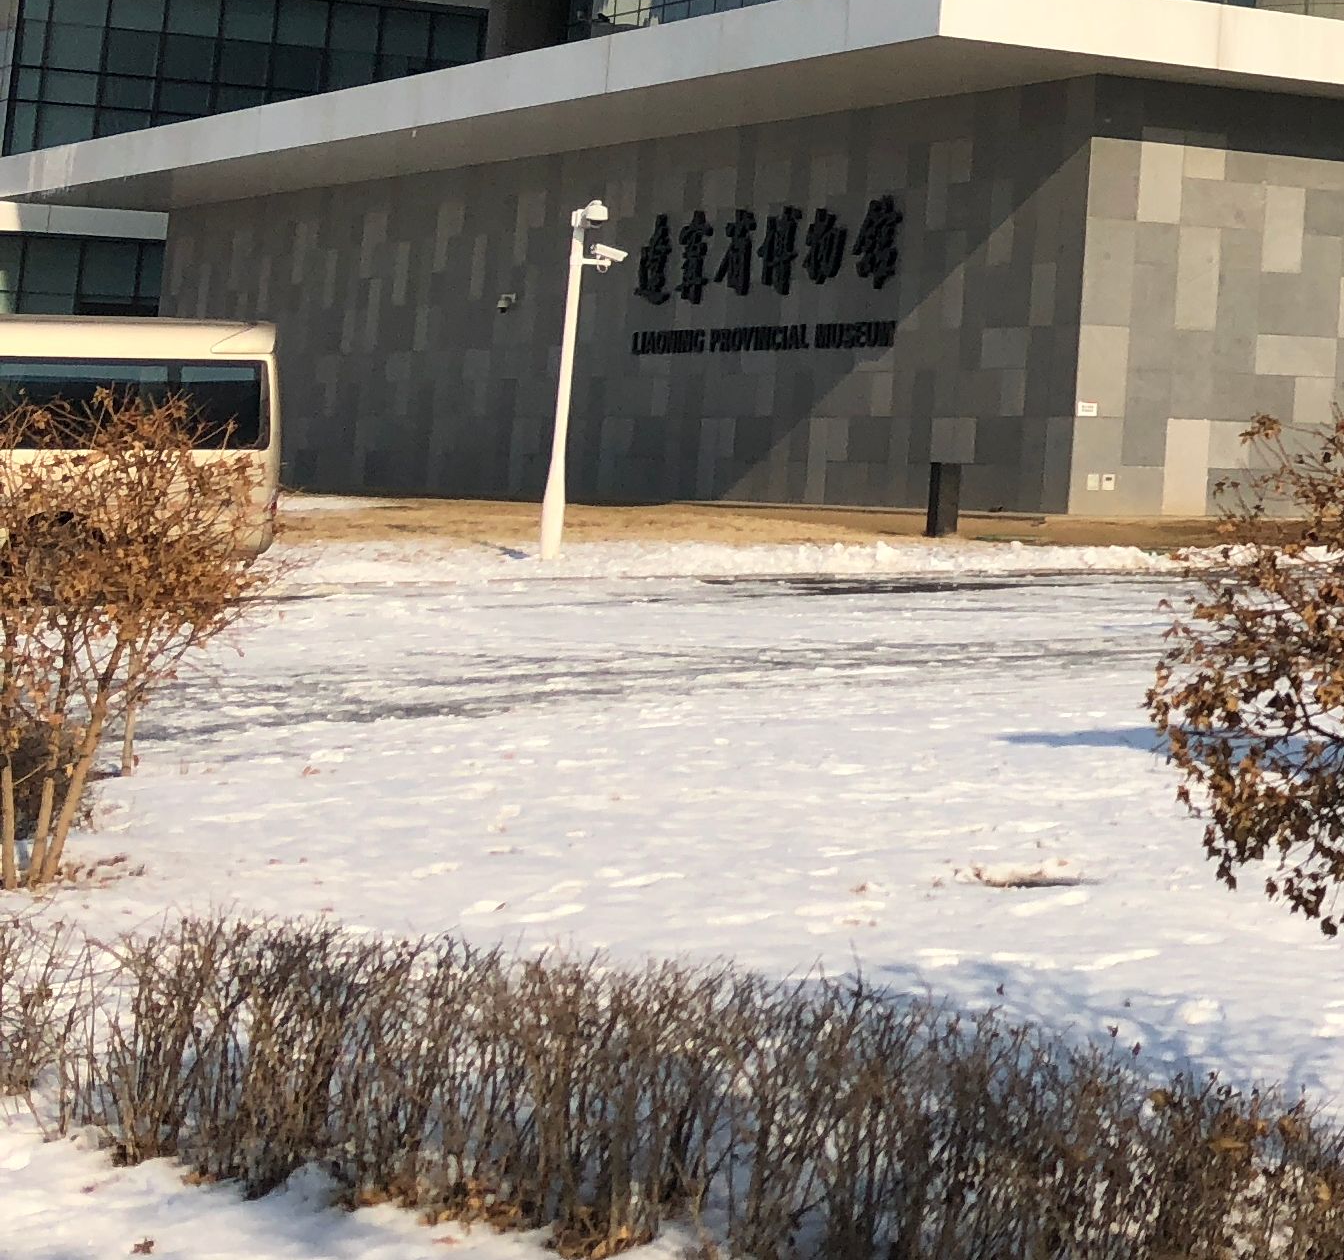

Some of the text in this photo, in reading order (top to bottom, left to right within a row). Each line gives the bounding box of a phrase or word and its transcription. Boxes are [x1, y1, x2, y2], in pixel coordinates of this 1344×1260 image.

[631, 320, 897, 355] LIAONING PROVINCIAL MUSEUM
